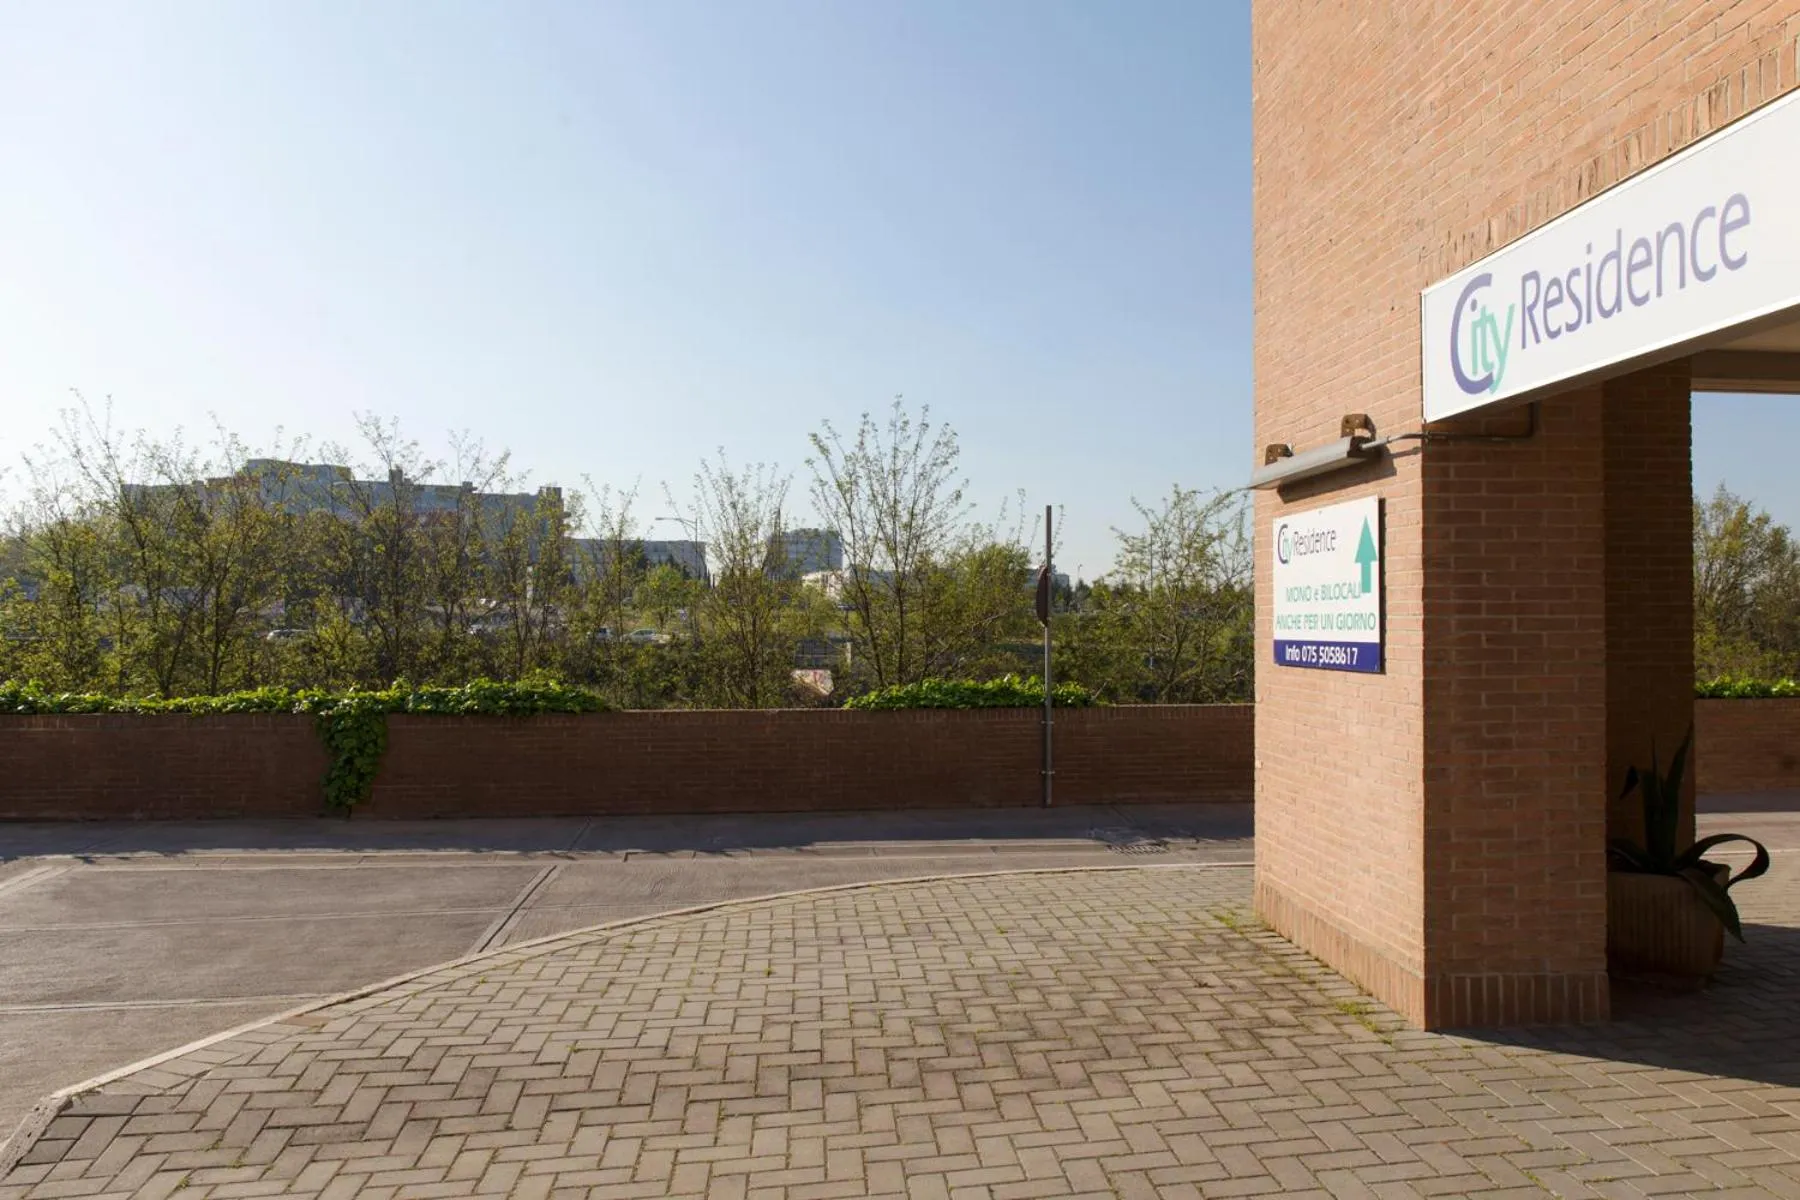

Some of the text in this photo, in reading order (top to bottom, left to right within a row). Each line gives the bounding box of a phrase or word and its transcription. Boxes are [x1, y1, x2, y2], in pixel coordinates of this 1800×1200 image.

[1450, 192, 1751, 395] City Residence
[1293, 529, 1336, 557] Residence
[1286, 585, 1312, 603] MONO
[1276, 612, 1376, 631] ANCHE PER UN GIORNO
[1285, 644, 1358, 666] Info 075 5058617
